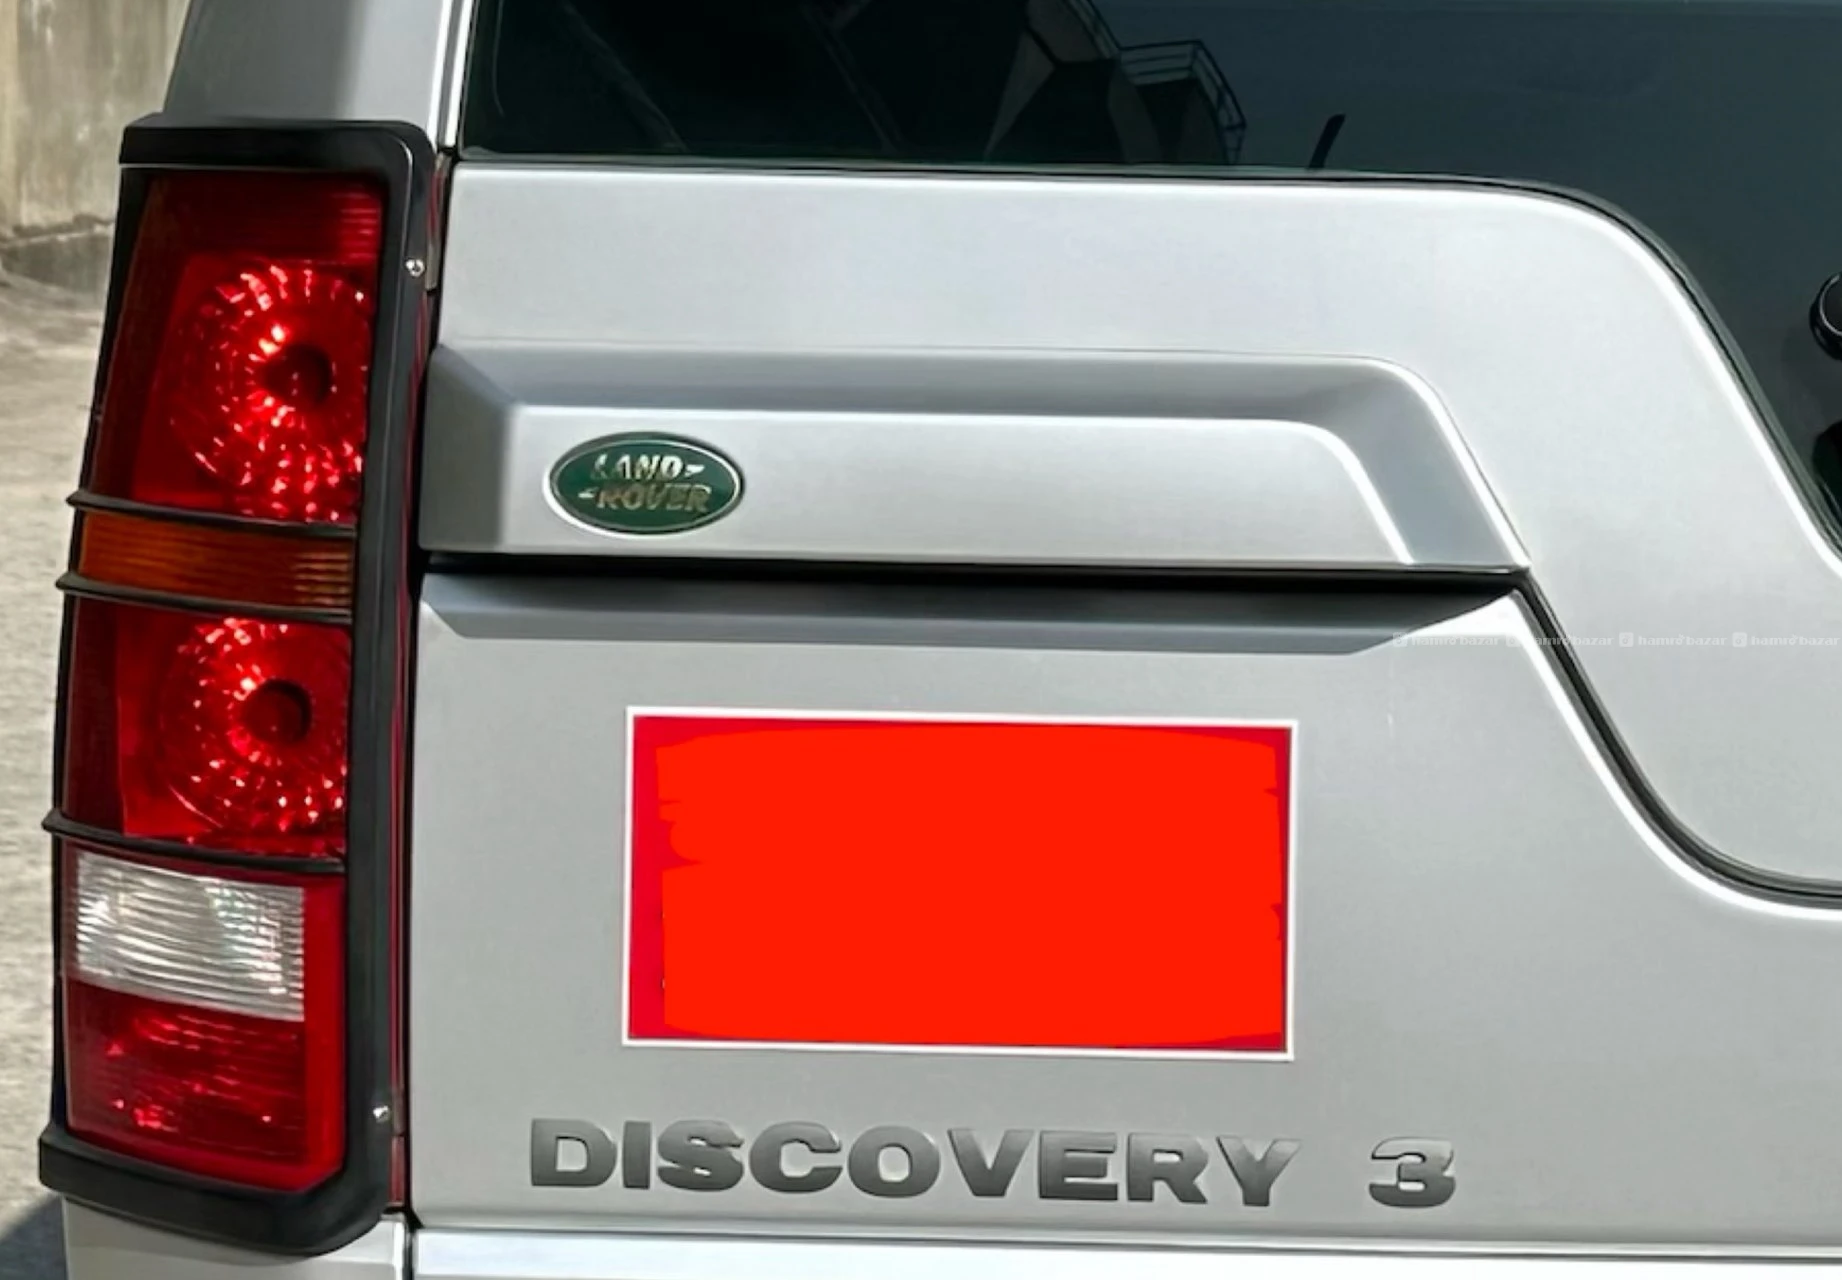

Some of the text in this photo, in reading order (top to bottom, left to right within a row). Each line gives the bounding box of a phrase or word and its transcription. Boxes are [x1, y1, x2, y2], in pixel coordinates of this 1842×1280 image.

[589, 454, 684, 481] LAND
[595, 482, 713, 512] ROVER
[530, 1117, 1458, 1209] DISCOVERY 3
